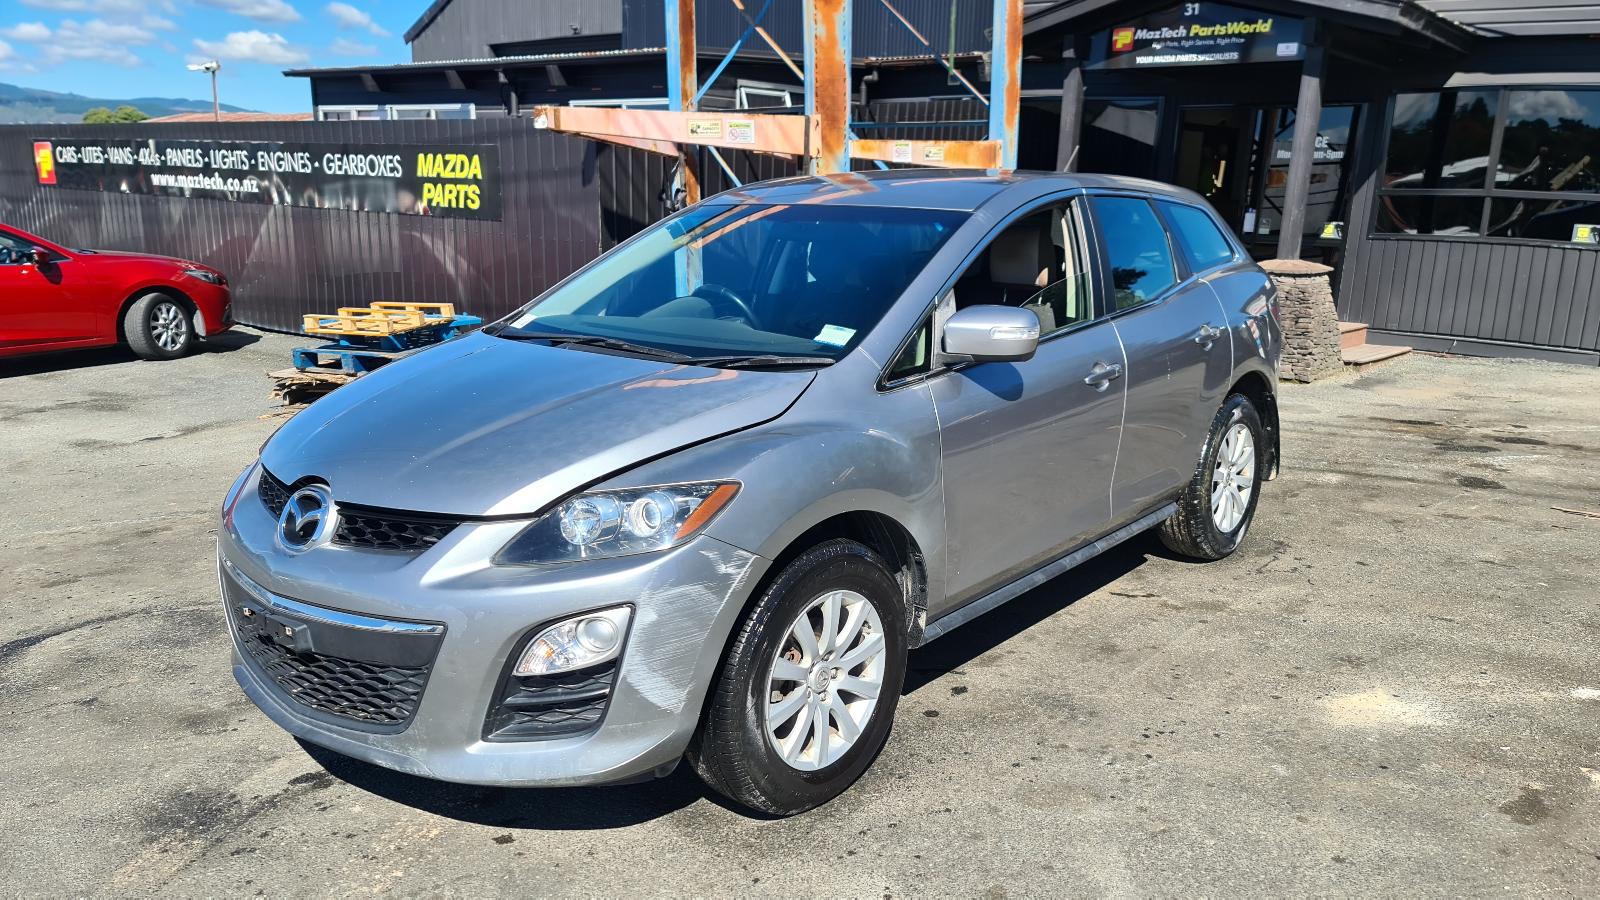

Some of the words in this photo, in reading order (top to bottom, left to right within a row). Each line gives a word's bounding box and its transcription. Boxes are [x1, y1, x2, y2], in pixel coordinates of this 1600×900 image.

[1184, 3, 1200, 16] 31
[1134, 25, 1187, 41] MazTech
[1189, 18, 1273, 37] PartsWorld
[55, 145, 77, 163] CARS
[80, 146, 104, 164] UTES
[107, 146, 134, 165] VANS
[165, 148, 203, 168] PANELS
[209, 149, 249, 171] LIGHTS
[256, 150, 312, 174] ENGINES
[323, 153, 403, 178] GEARBOXES
[416, 153, 483, 180] MAZDA
[150, 172, 259, 193] www.maztech.co.nz
[421, 182, 481, 210] PARTS
